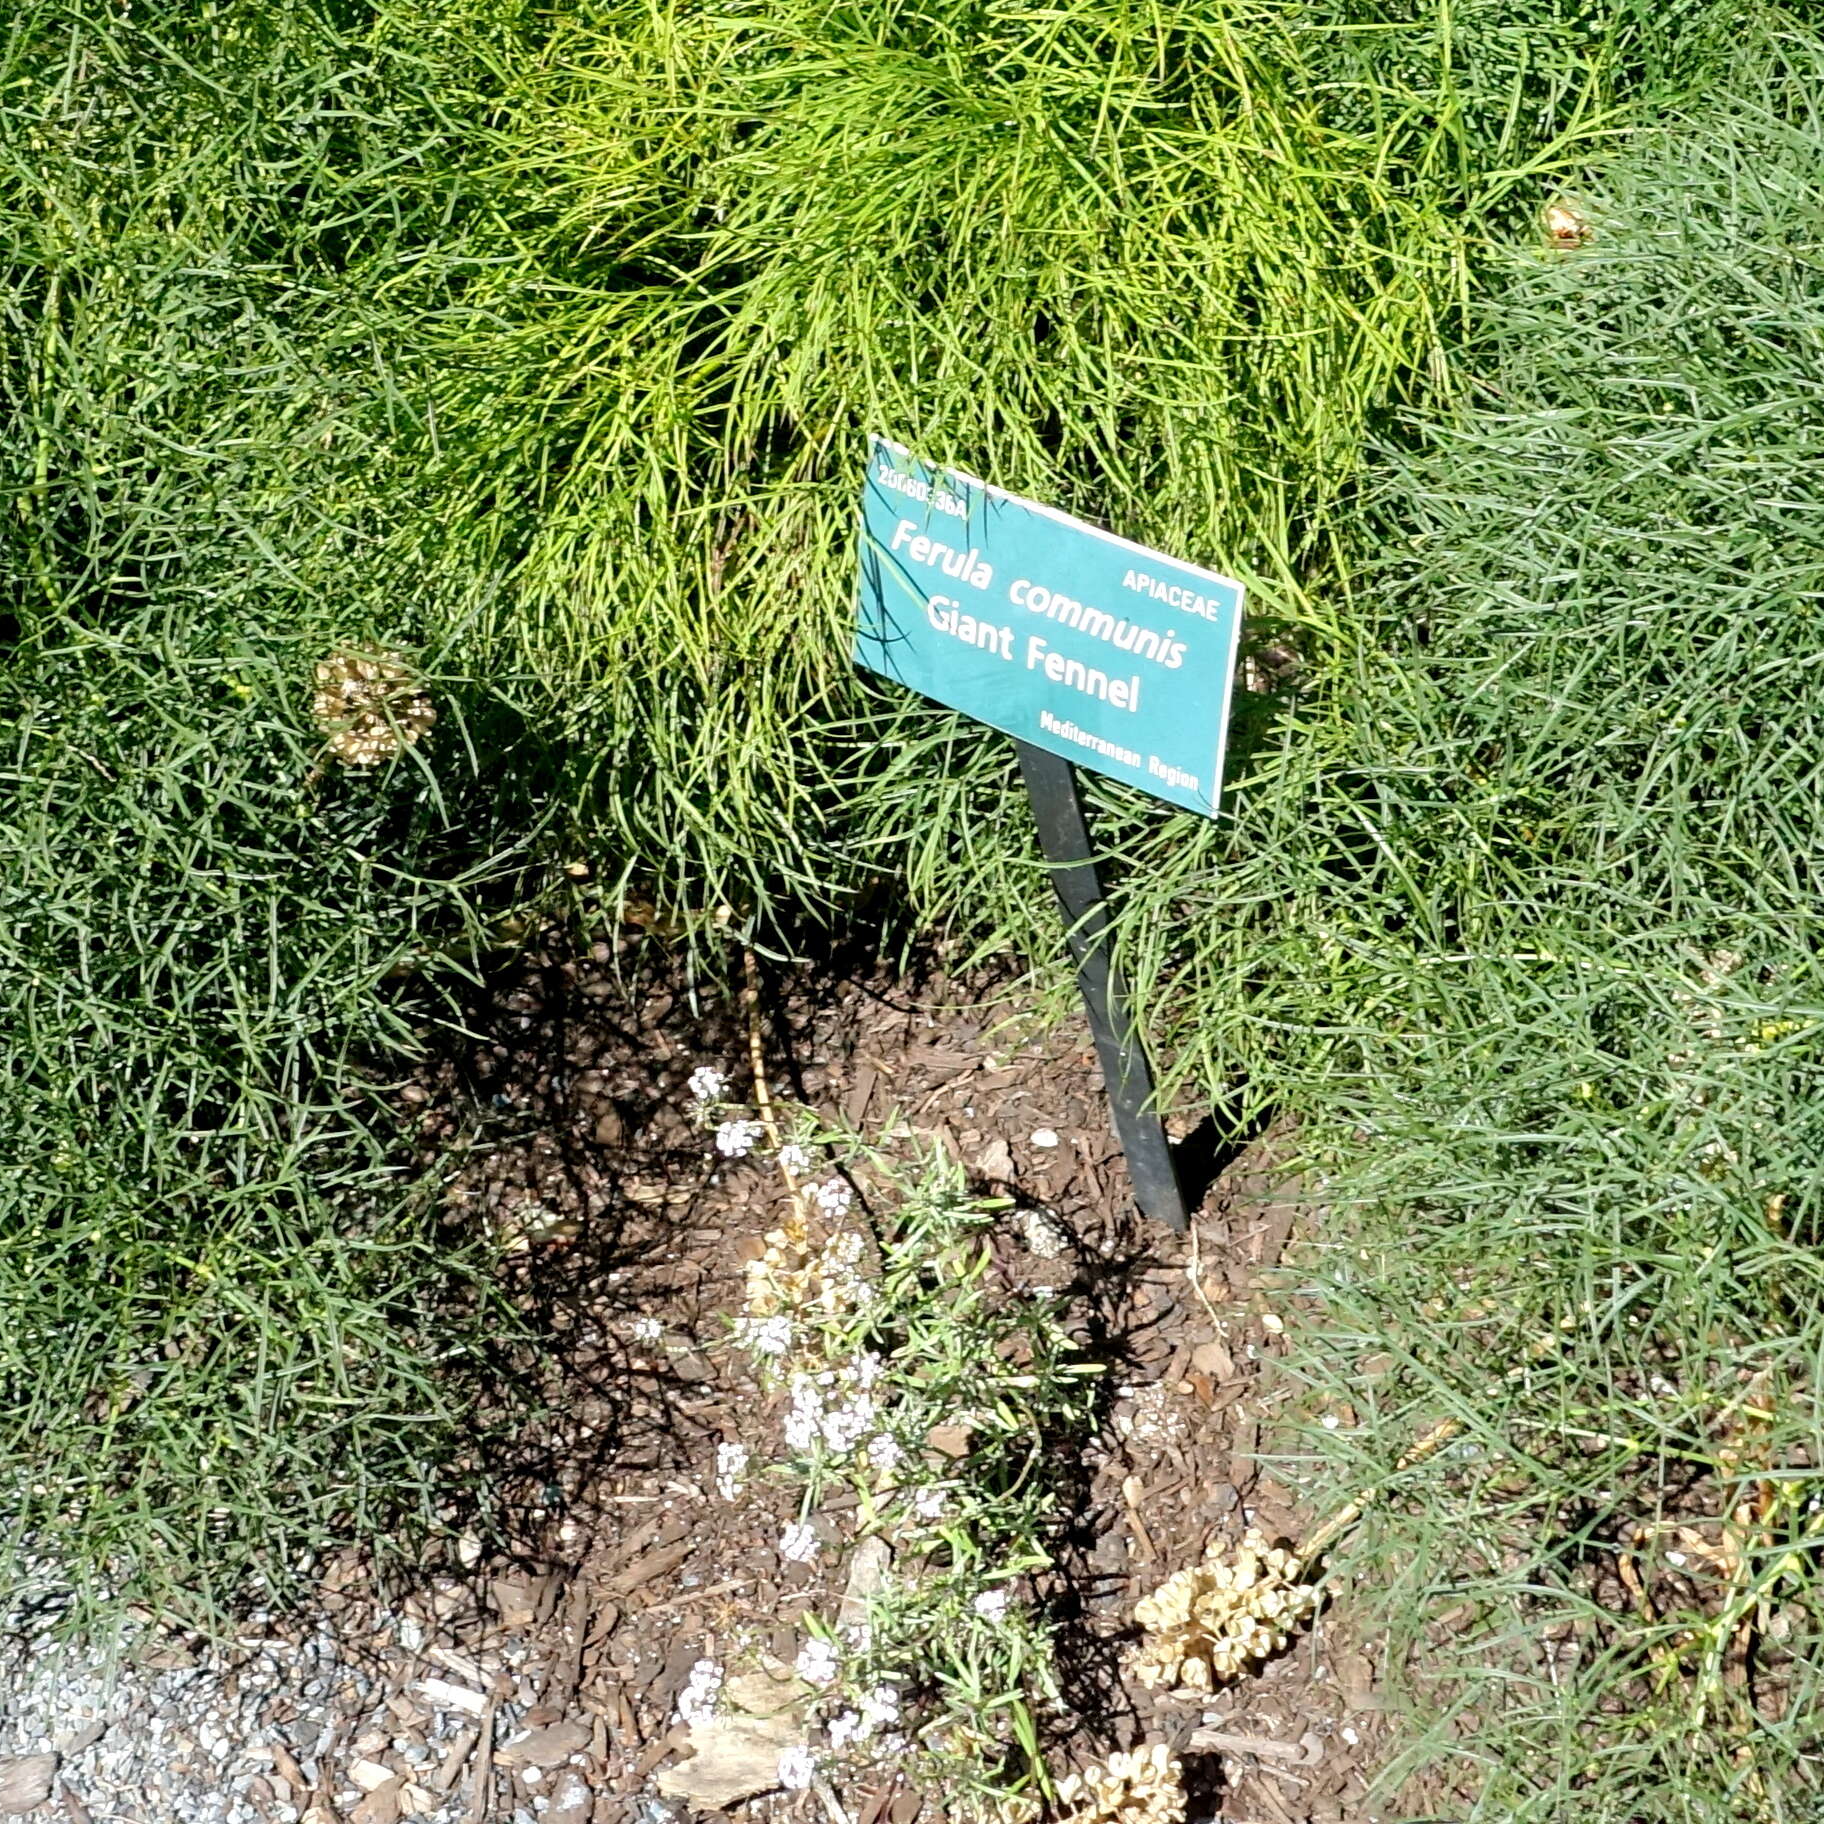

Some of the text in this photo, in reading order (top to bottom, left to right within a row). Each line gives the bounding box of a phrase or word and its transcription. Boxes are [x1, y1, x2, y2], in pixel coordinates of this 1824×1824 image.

[891, 519, 1188, 669] Ferula communis
[1122, 569, 1223, 622] APIACEAE
[927, 595, 1140, 713] Giant Fennel
[1039, 711, 1199, 791] Mediterranean Region
